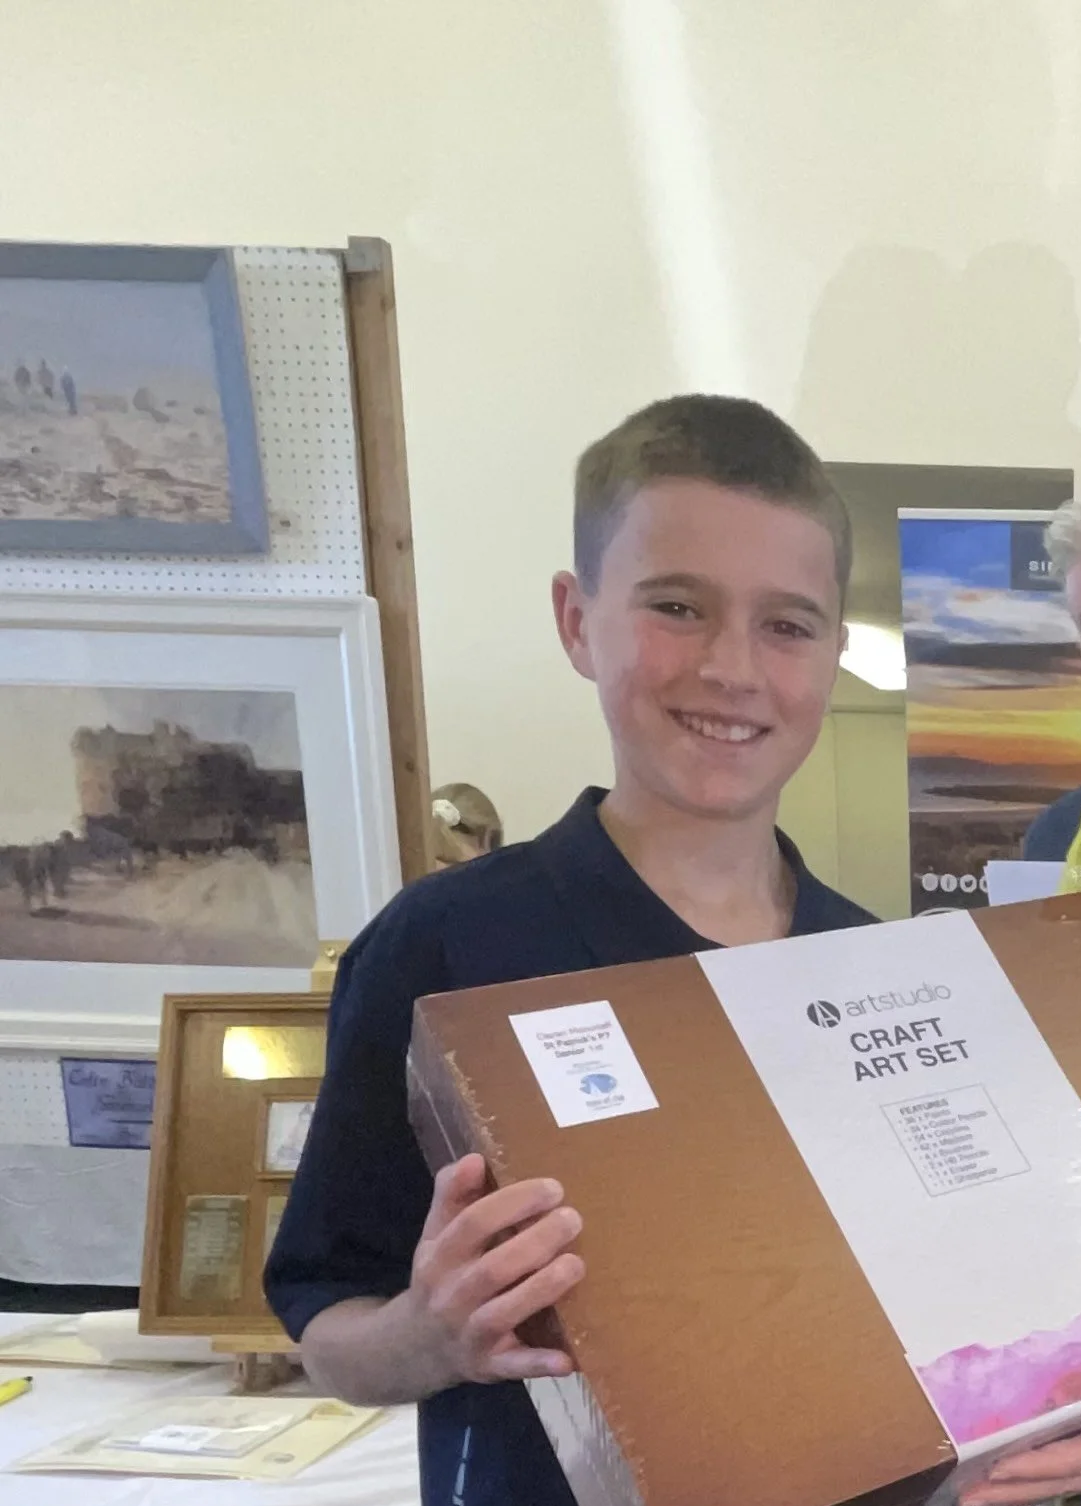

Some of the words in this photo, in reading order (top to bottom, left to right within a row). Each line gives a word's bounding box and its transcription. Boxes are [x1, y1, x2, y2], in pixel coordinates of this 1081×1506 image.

[844, 981, 951, 1017] artstudio
[850, 1017, 943, 1053] CRAFT
[854, 1052, 909, 1082] ART
[916, 1039, 969, 1067] SET
